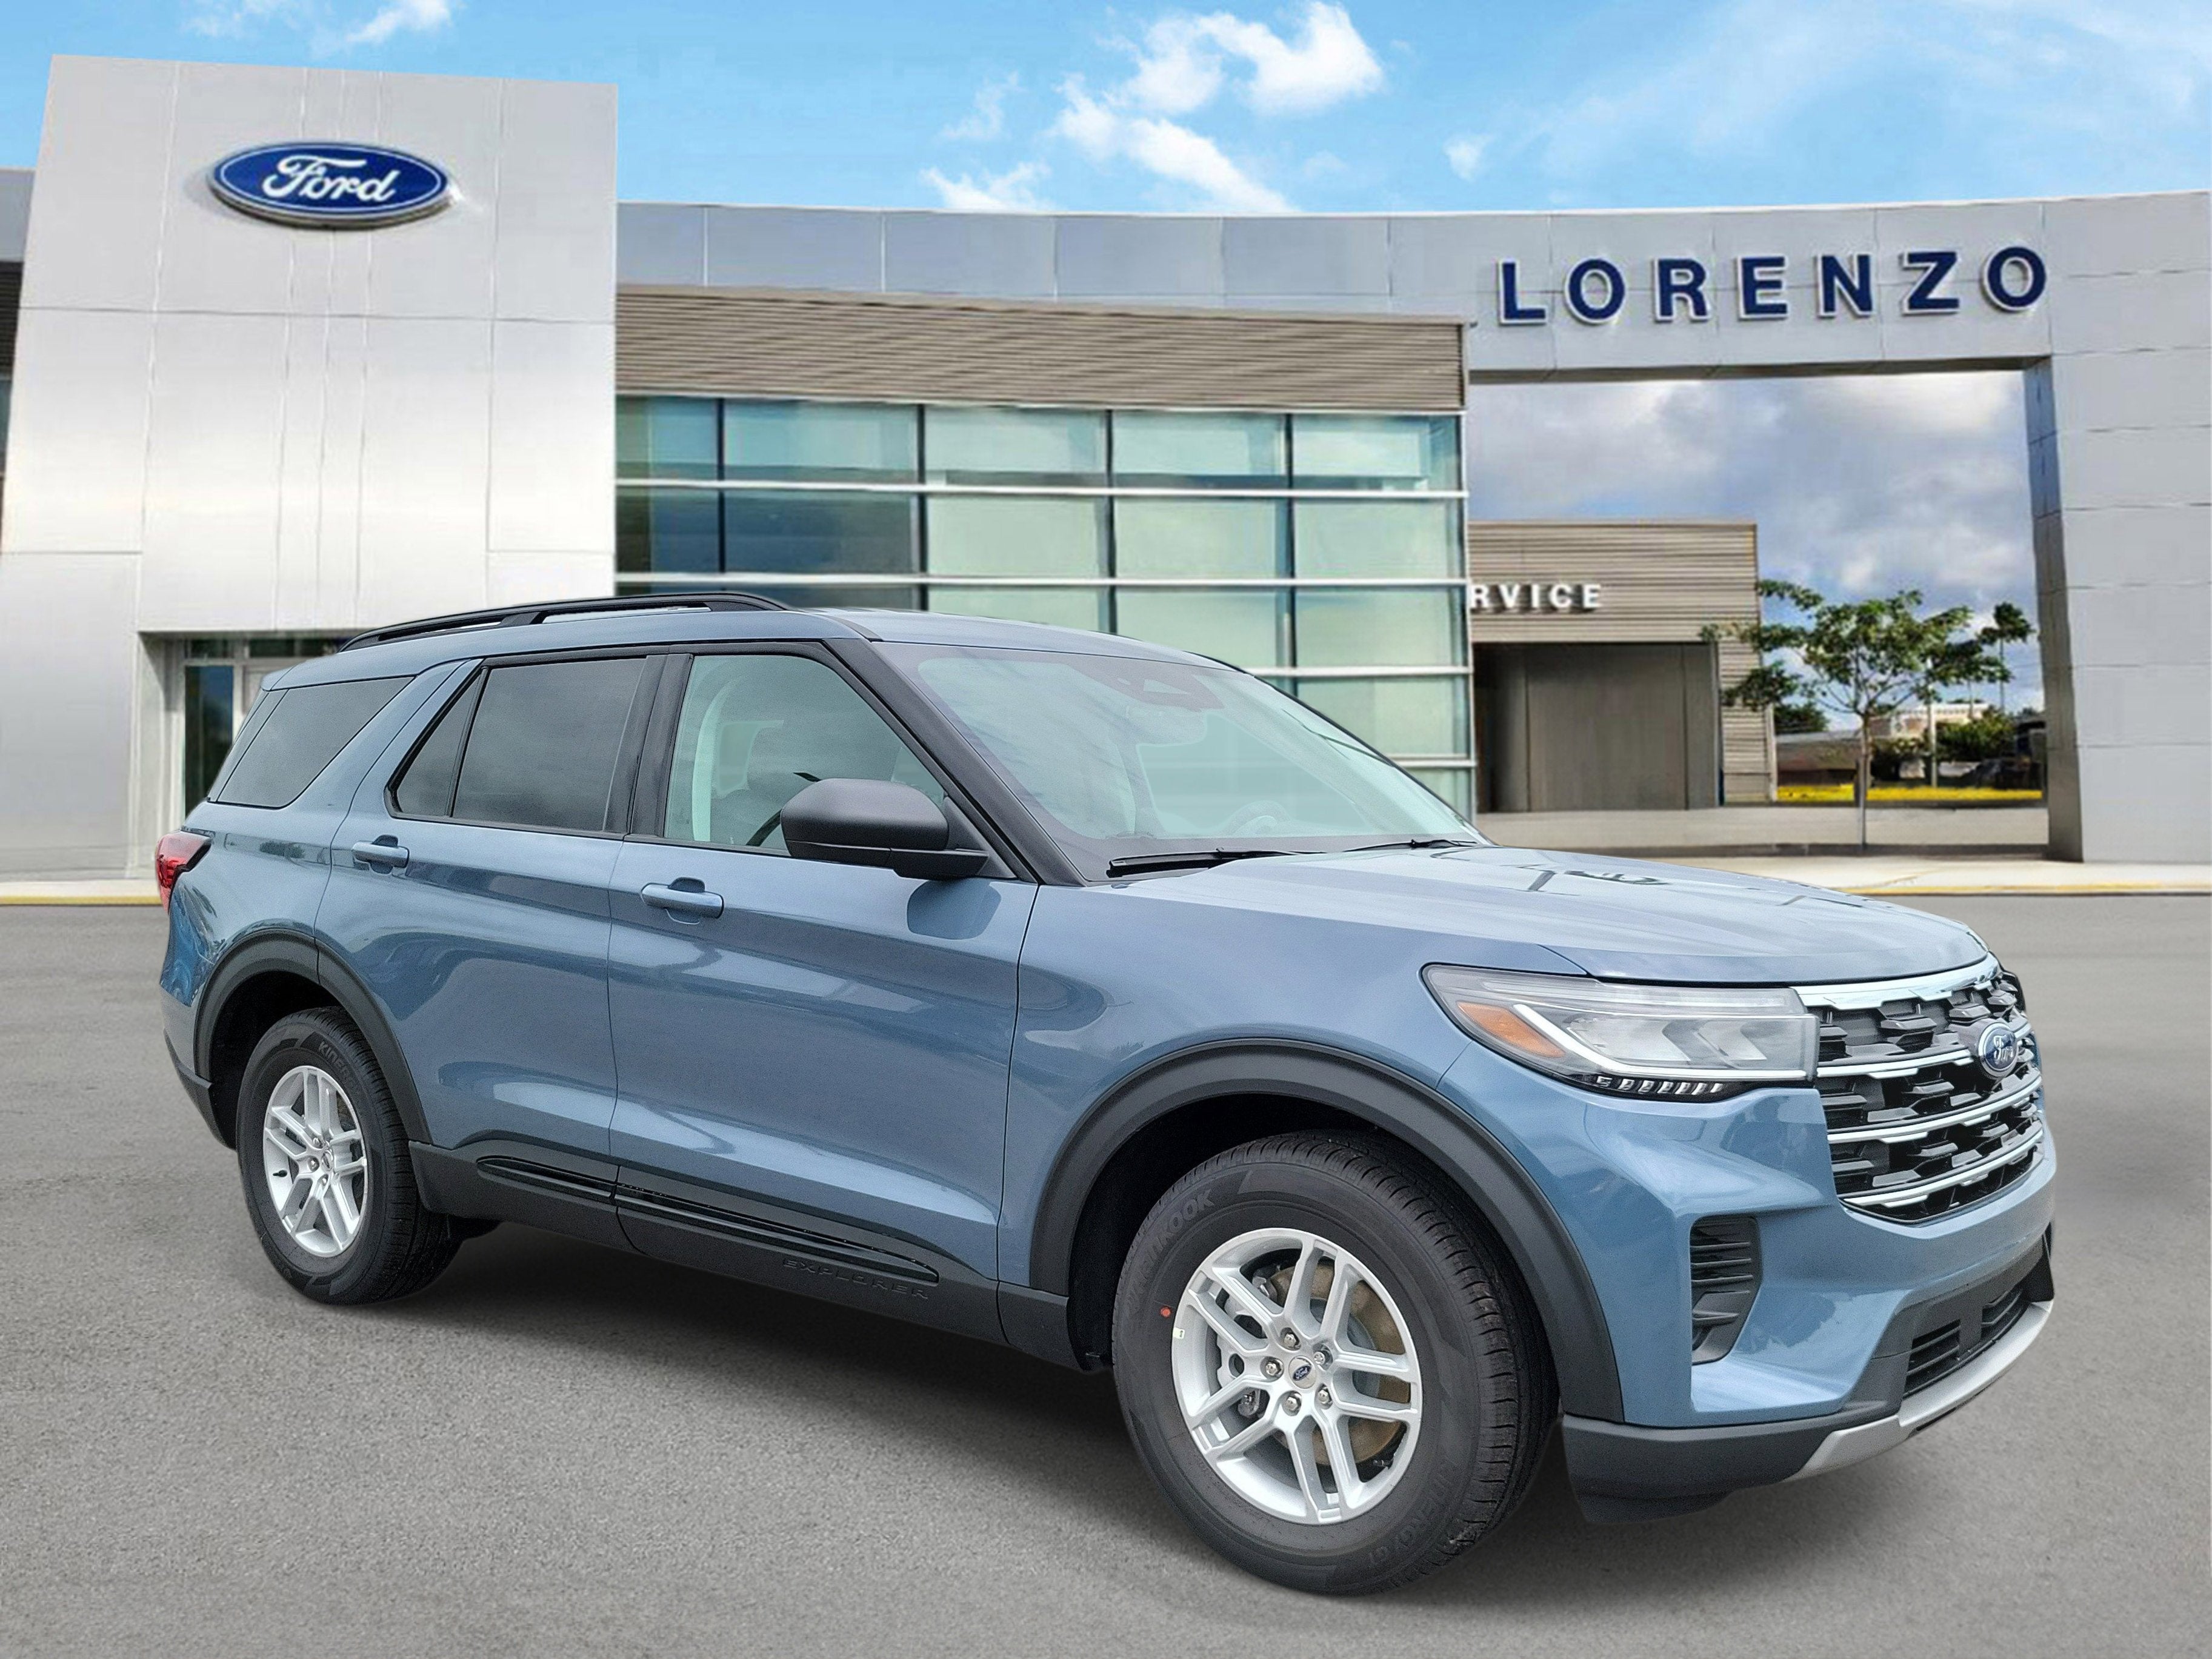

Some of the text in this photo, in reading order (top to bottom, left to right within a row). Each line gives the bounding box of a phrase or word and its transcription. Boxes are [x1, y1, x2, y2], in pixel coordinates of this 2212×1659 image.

[262, 155, 401, 202] Ford
[1496, 245, 2048, 326] LORENZO
[1471, 583, 1602, 609] RVICE
[1993, 1034, 2013, 1061] Ford
[782, 1257, 928, 1300] EXPLORER
